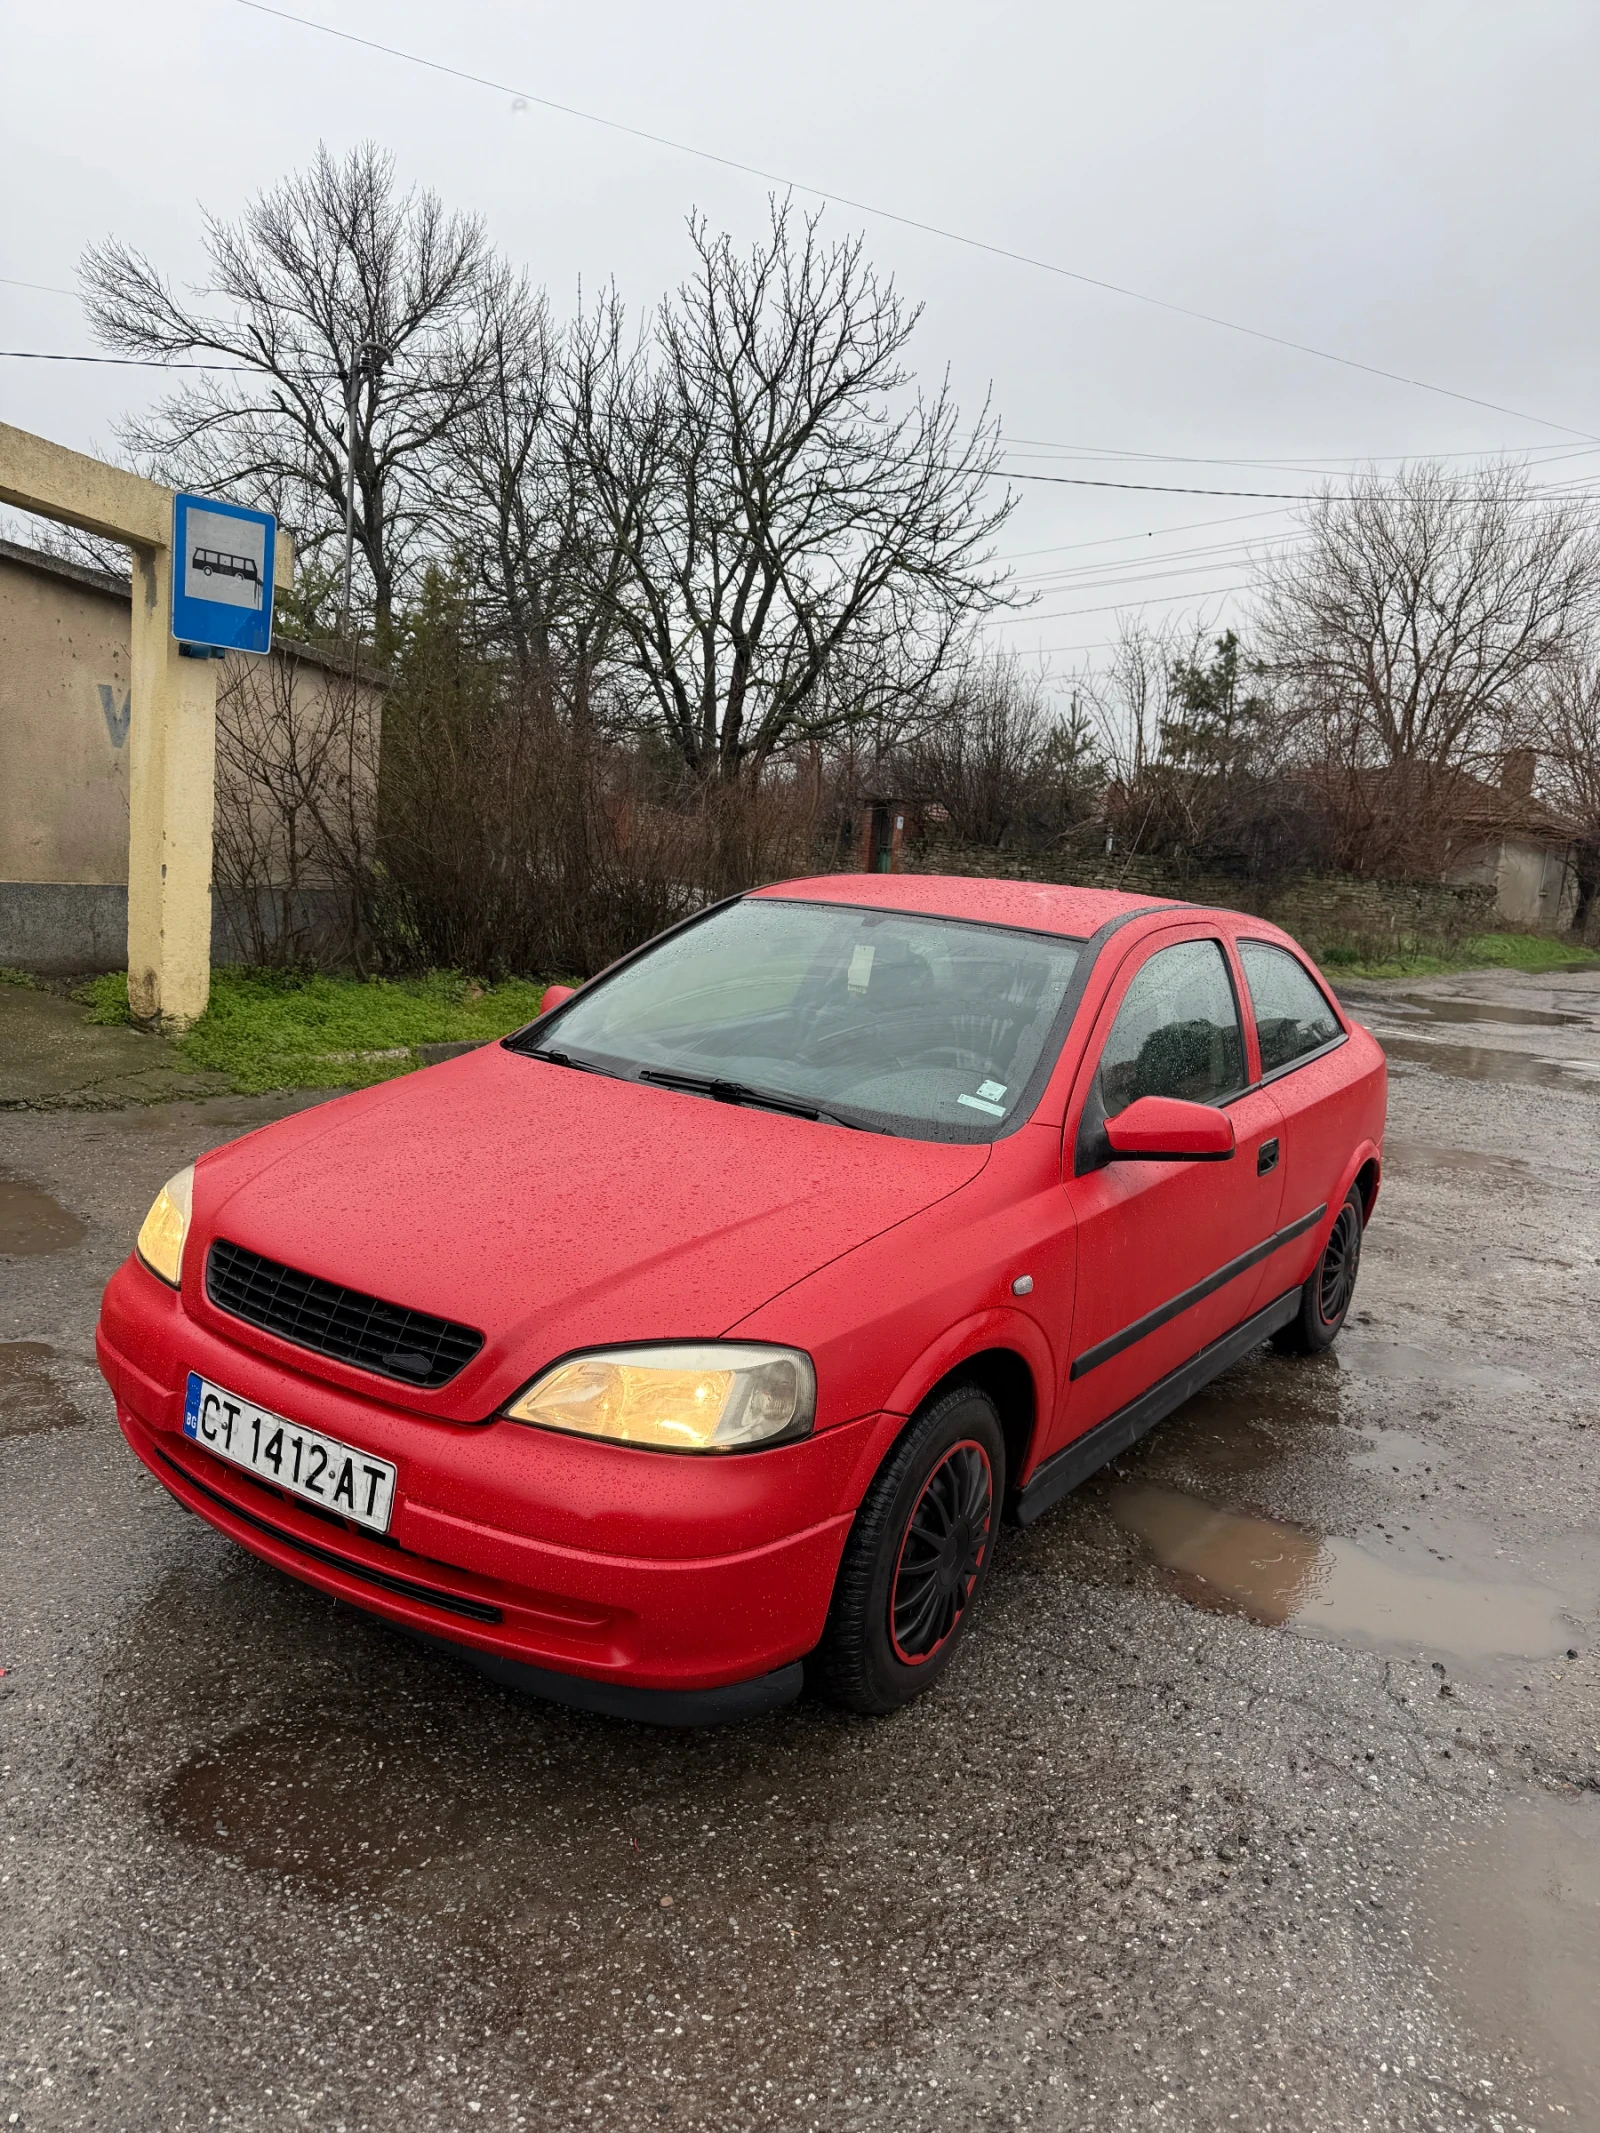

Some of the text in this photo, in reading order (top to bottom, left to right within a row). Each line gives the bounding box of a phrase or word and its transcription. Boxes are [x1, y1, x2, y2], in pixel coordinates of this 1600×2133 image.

[186, 1412, 197, 1429] BG
[201, 1393, 386, 1517] CT 1412 AT
